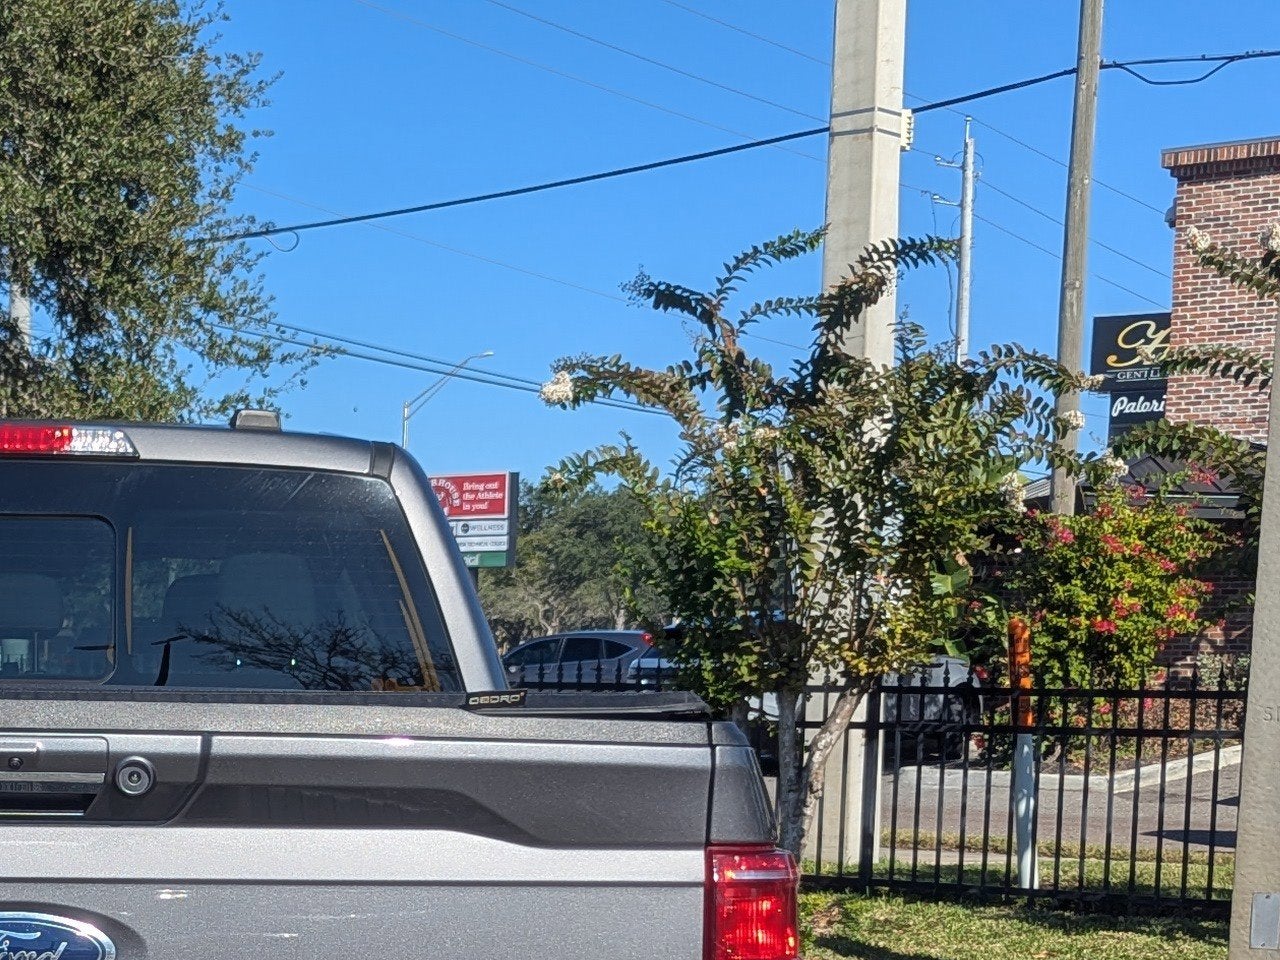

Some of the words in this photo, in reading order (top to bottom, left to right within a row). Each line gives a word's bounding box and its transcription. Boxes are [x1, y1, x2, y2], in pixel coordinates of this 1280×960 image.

[462, 482, 484, 491] Bring
[485, 481, 498, 489] out
[462, 492, 476, 500] the
[476, 491, 504, 500] Athlete
